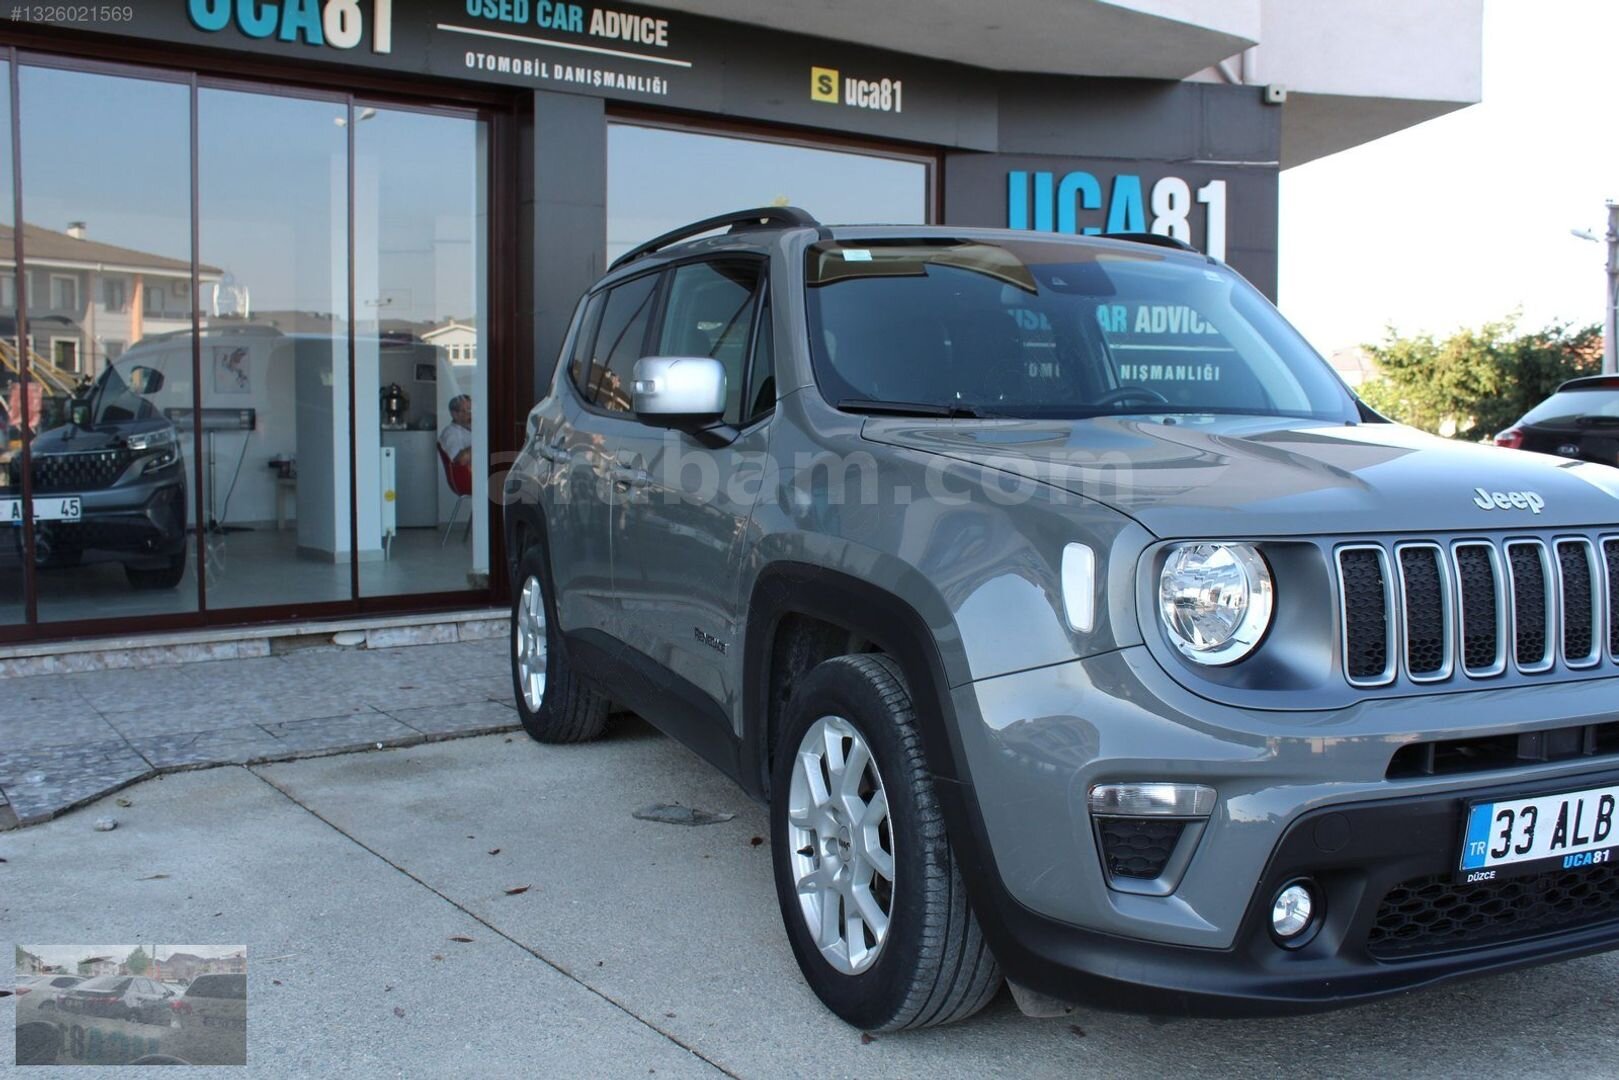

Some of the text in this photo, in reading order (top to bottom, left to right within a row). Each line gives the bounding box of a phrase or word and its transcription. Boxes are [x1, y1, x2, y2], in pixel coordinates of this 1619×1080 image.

[466, 0, 668, 47] USED CAR ADVICE
[465, 52, 668, 95] OTOMOBİL DANIŞMANLIĞI
[845, 77, 902, 113] uca81
[1120, 362, 1221, 383] NIŞMANLIĞI
[61, 500, 79, 516] 45
[1473, 487, 1545, 515] Jeep
[1470, 794, 1615, 859] TR 33 ALB
[1563, 849, 1610, 868] UCA81
[1467, 870, 1496, 883] DÜZCE
